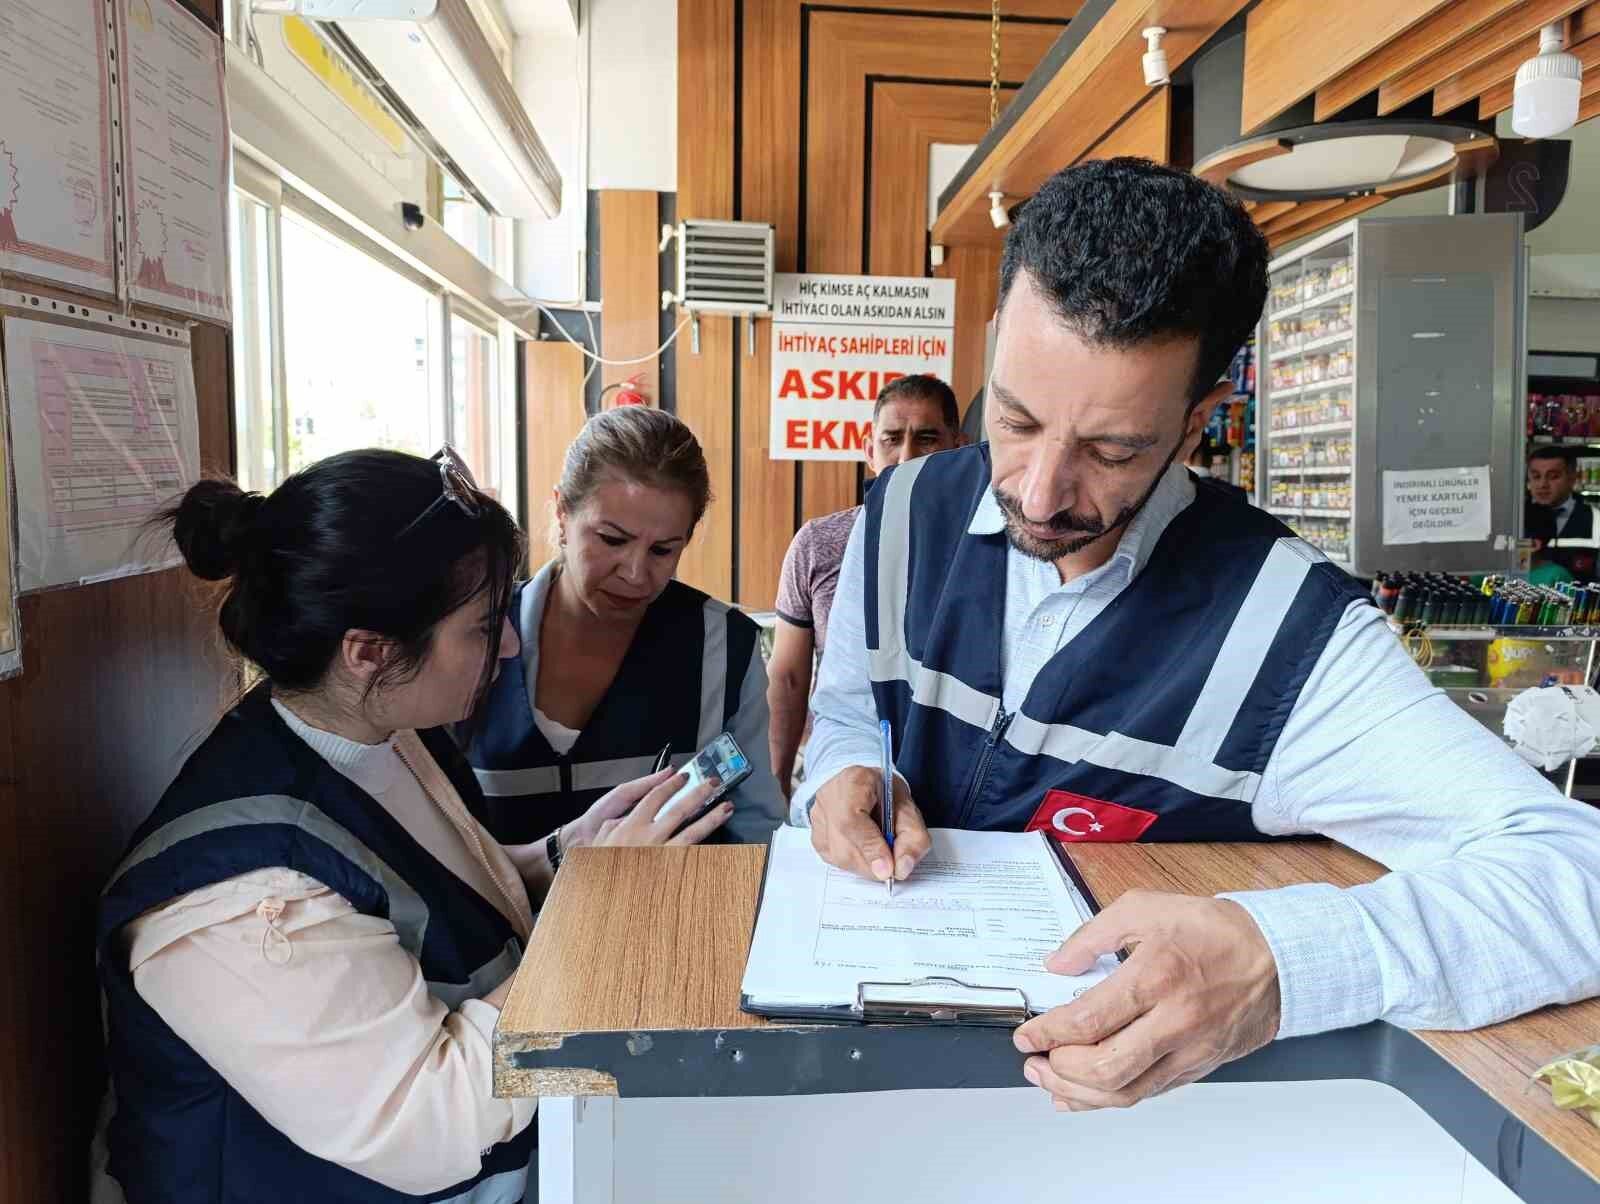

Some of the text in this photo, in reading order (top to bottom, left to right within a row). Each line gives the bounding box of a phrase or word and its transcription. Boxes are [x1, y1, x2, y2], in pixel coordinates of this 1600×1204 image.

[799, 279, 930, 300] HİÇ KİMSE AÇ KALMASIN
[781, 300, 946, 320] İHTİYACI OLAN ASKIDAN ALSIN
[779, 331, 946, 361] İHTİYAÇ SAHİPLERİ İÇİN
[786, 420, 873, 450] EKM
[1396, 492, 1477, 503] YEMEK KARTLARI
